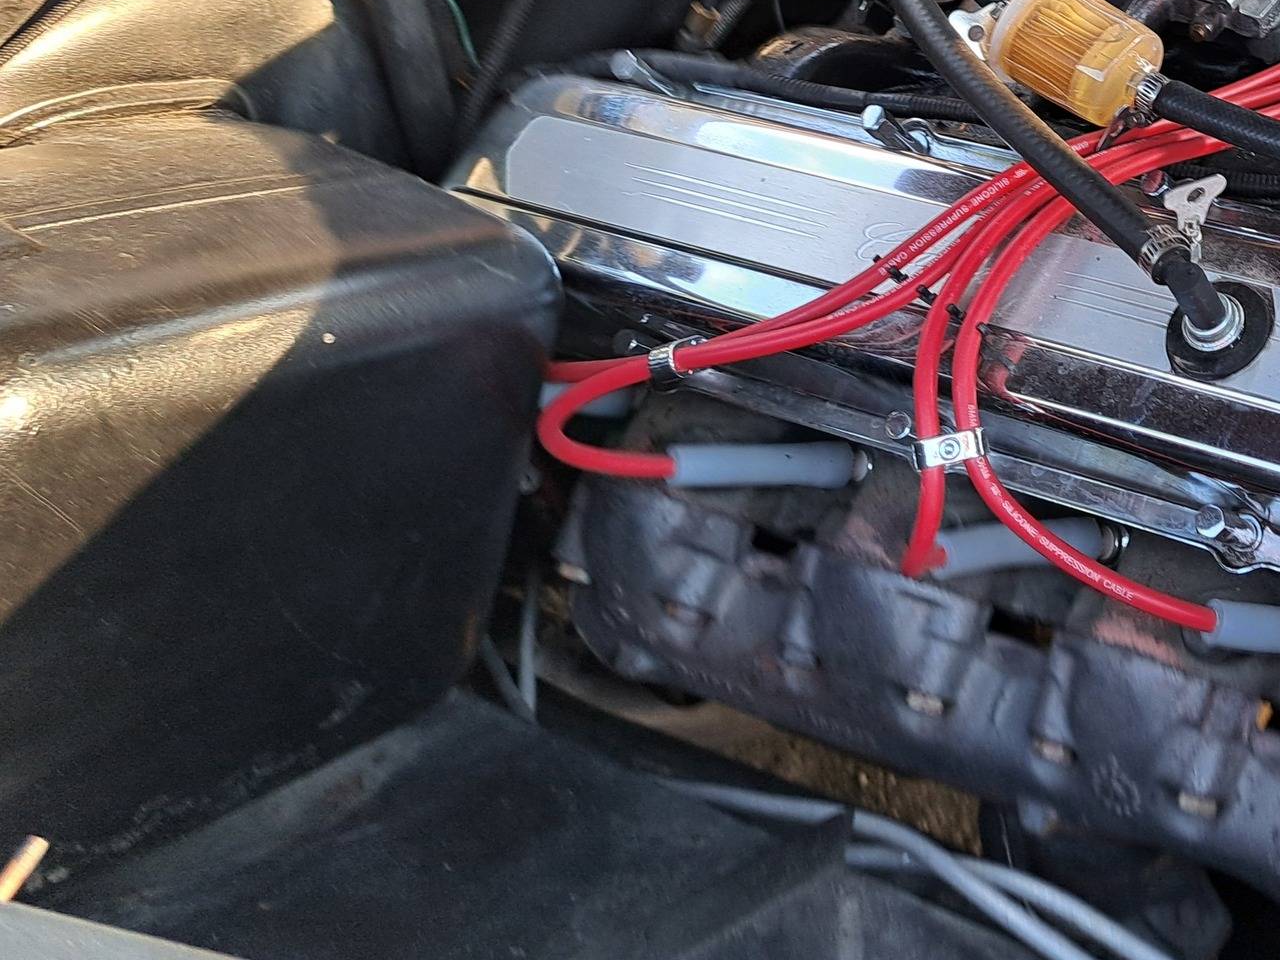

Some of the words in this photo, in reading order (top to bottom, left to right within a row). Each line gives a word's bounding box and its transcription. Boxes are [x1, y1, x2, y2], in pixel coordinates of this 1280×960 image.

[970, 176, 1010, 207] SILICONE
[909, 203, 970, 252] SUPPRESSION
[1002, 500, 1039, 537] SILICONE
[1038, 535, 1101, 583] SUPPRESSION
[1102, 579, 1136, 601] CABLE
